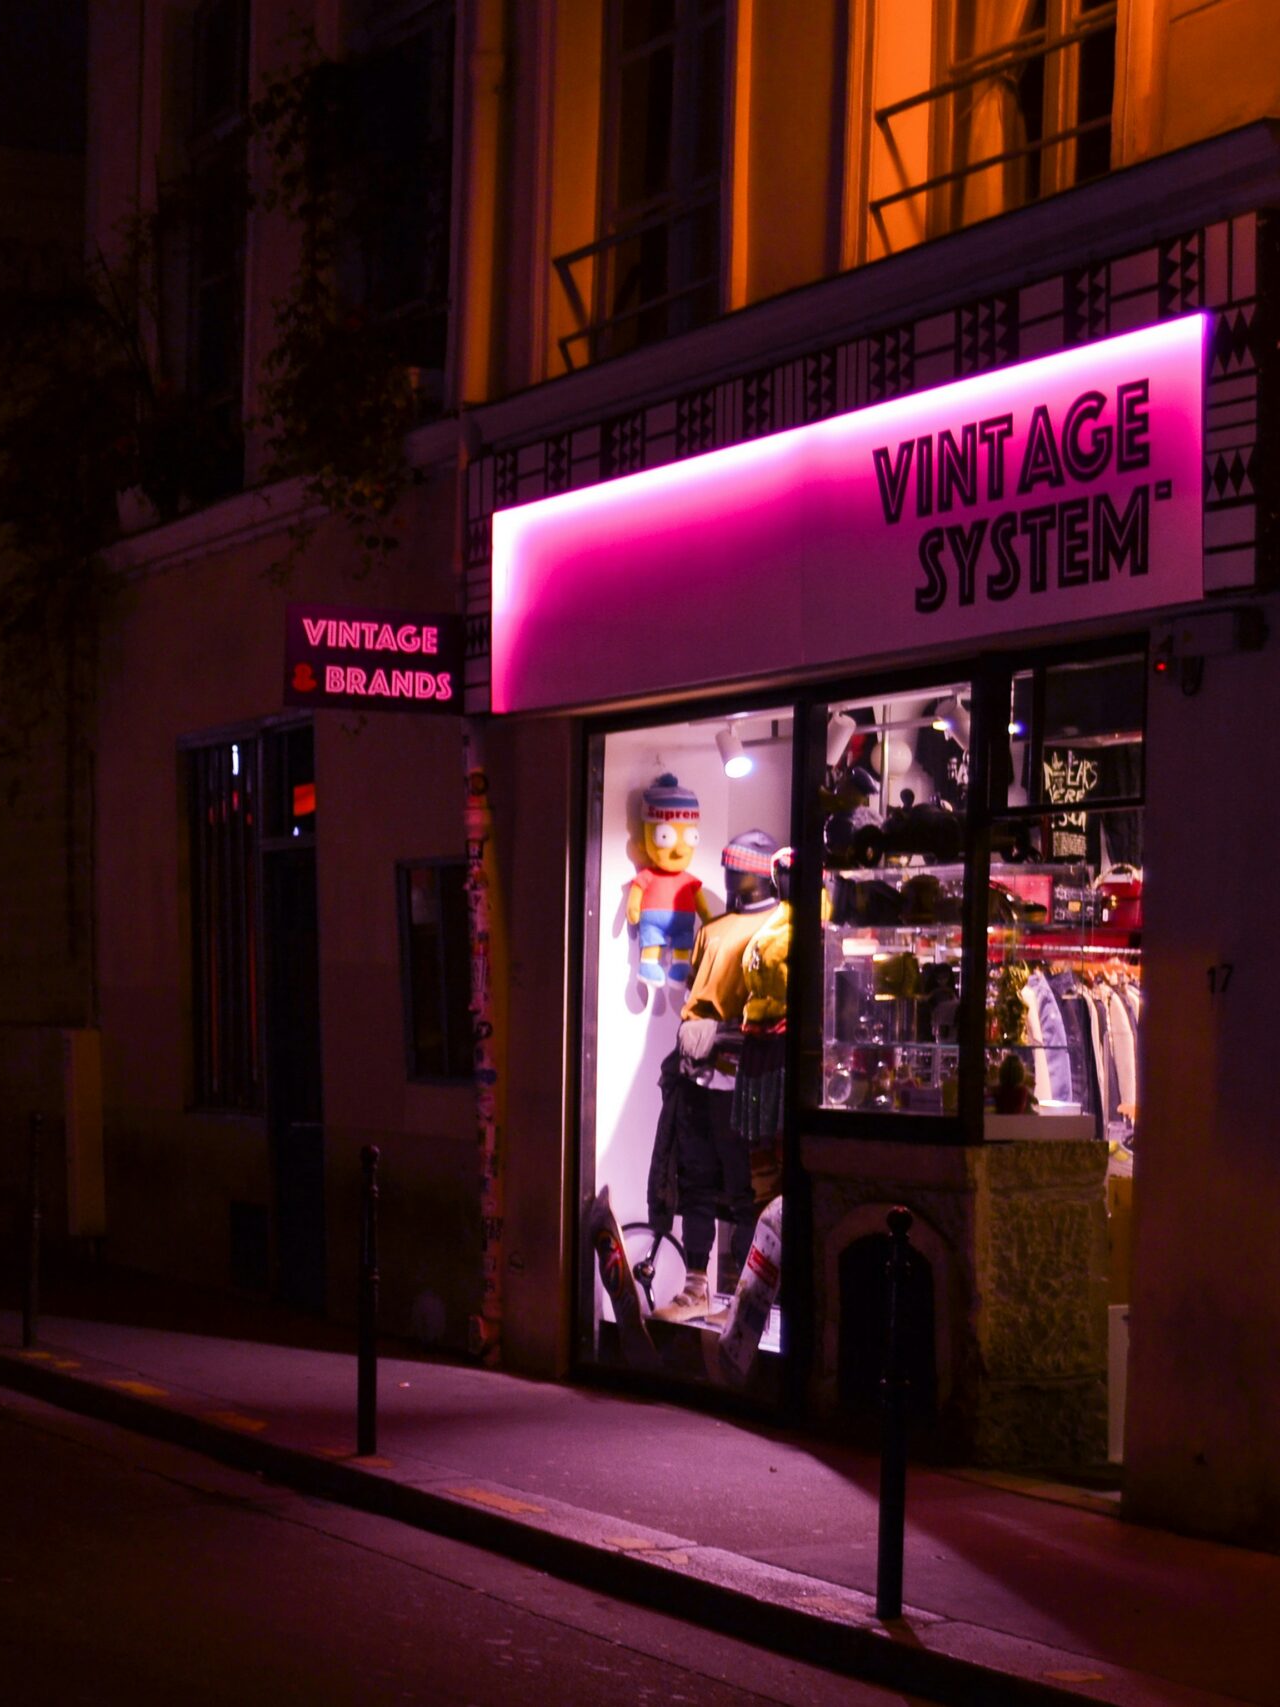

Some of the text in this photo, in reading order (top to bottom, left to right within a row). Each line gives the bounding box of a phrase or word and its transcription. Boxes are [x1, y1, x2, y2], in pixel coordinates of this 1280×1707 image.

[872, 378, 1150, 525] VINTAGE
[915, 484, 1150, 614] SYSTEM
[302, 617, 438, 655] VINTAGE
[293, 663, 453, 701] & BRANDS
[1207, 964, 1233, 993] 17
